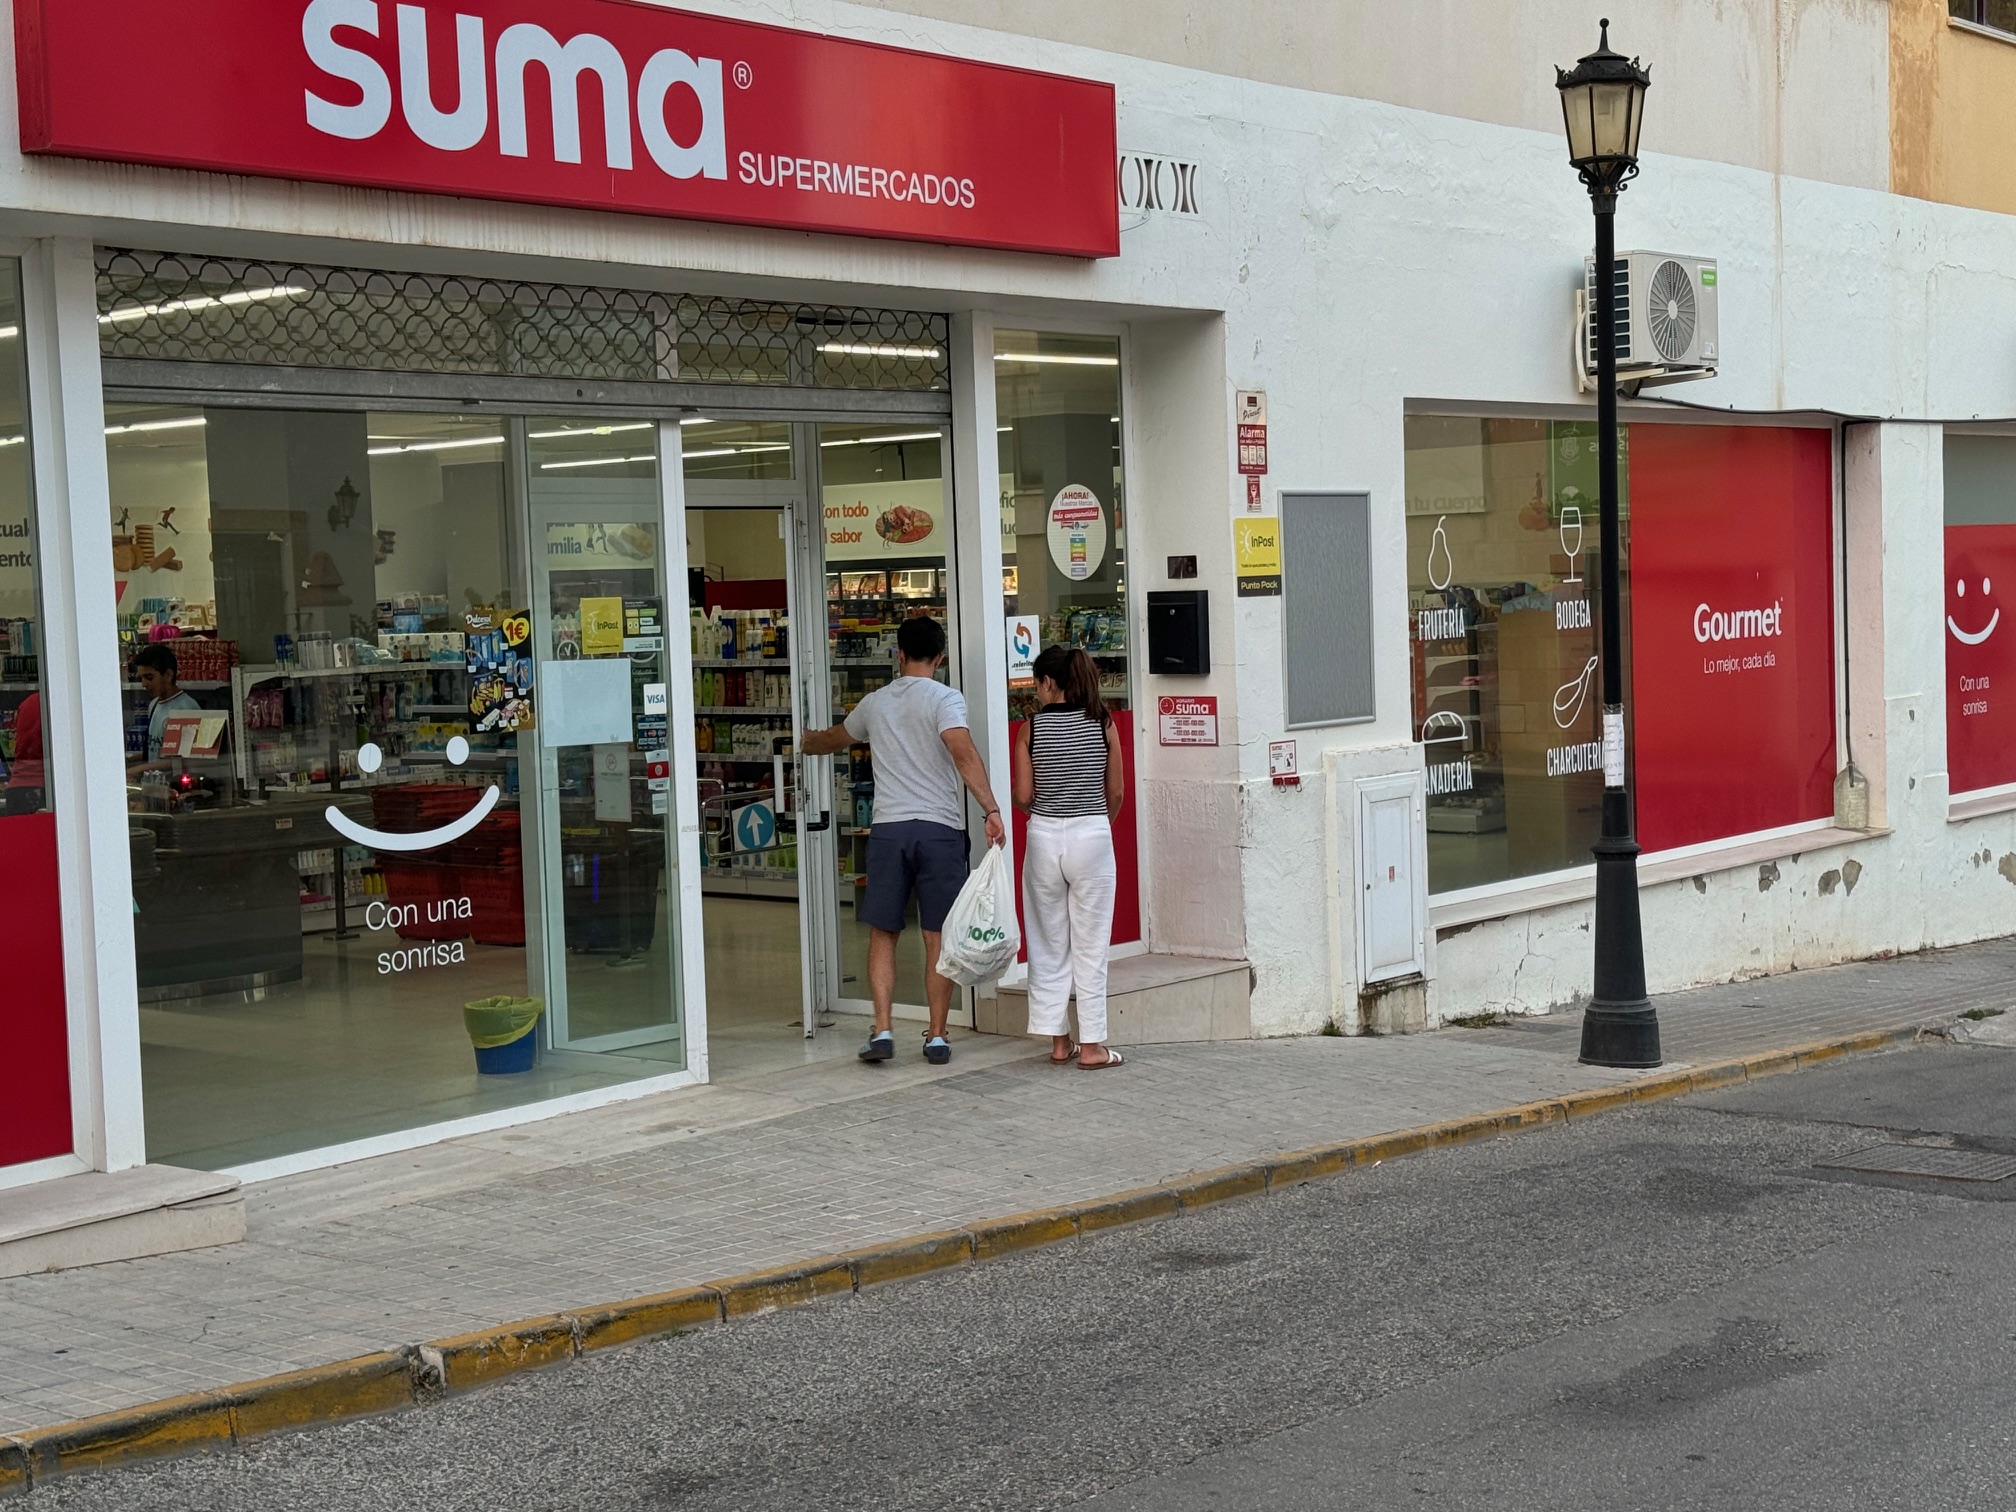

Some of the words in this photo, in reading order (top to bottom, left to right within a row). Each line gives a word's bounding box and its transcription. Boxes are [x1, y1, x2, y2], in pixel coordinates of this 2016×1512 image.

[302, 0, 727, 181] suma
[738, 151, 976, 209] SUPERMERCADOS
[1239, 426, 1265, 439] Alarma
[842, 500, 869, 518] todo
[830, 526, 863, 544] sabor
[1251, 535, 1275, 548] InPost
[1240, 581, 1260, 590] Punto
[1260, 580, 1278, 589] Pack
[1418, 603, 1466, 642] FRUTERÍA
[1555, 599, 1592, 631] BODEGA
[1693, 600, 1782, 643] Gourmet
[505, 620, 526, 642] 1€
[596, 621, 619, 630] InPost
[1703, 657, 1715, 674] Lo
[1716, 654, 1740, 675] mejor,
[1742, 652, 1762, 669] cada
[1763, 650, 1776, 667] día
[1959, 674, 1975, 692] Con
[1976, 676, 1990, 690] una
[646, 694, 666, 704] VISA
[1962, 698, 1988, 716] sonrisa
[1175, 703, 1210, 715] suma
[365, 901, 418, 931] Con
[427, 896, 473, 923] una
[377, 938, 466, 975] sonrisa
